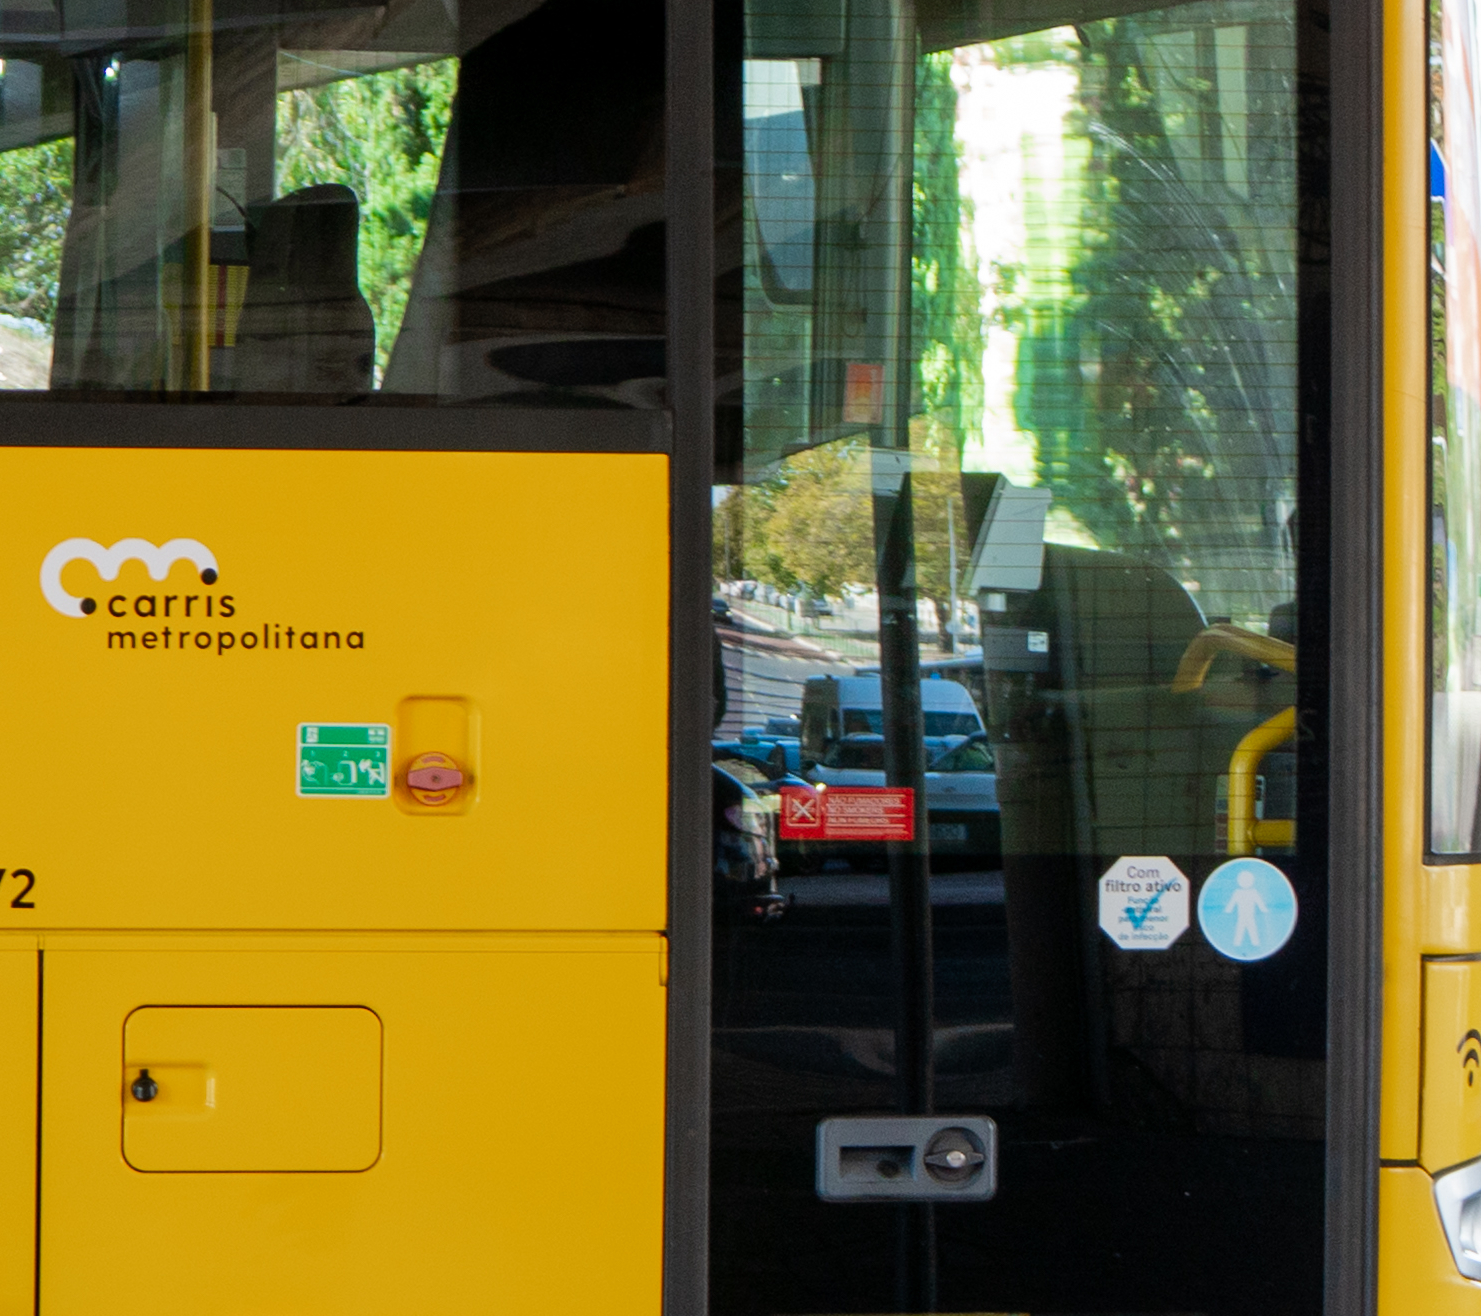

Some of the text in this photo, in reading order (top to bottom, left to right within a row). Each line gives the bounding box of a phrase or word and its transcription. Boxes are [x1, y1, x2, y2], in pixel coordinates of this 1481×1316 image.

[107, 594, 236, 618] carris
[107, 623, 365, 656] metropolitana
[1126, 865, 1160, 879] Com
[1105, 879, 1141, 892] filtro
